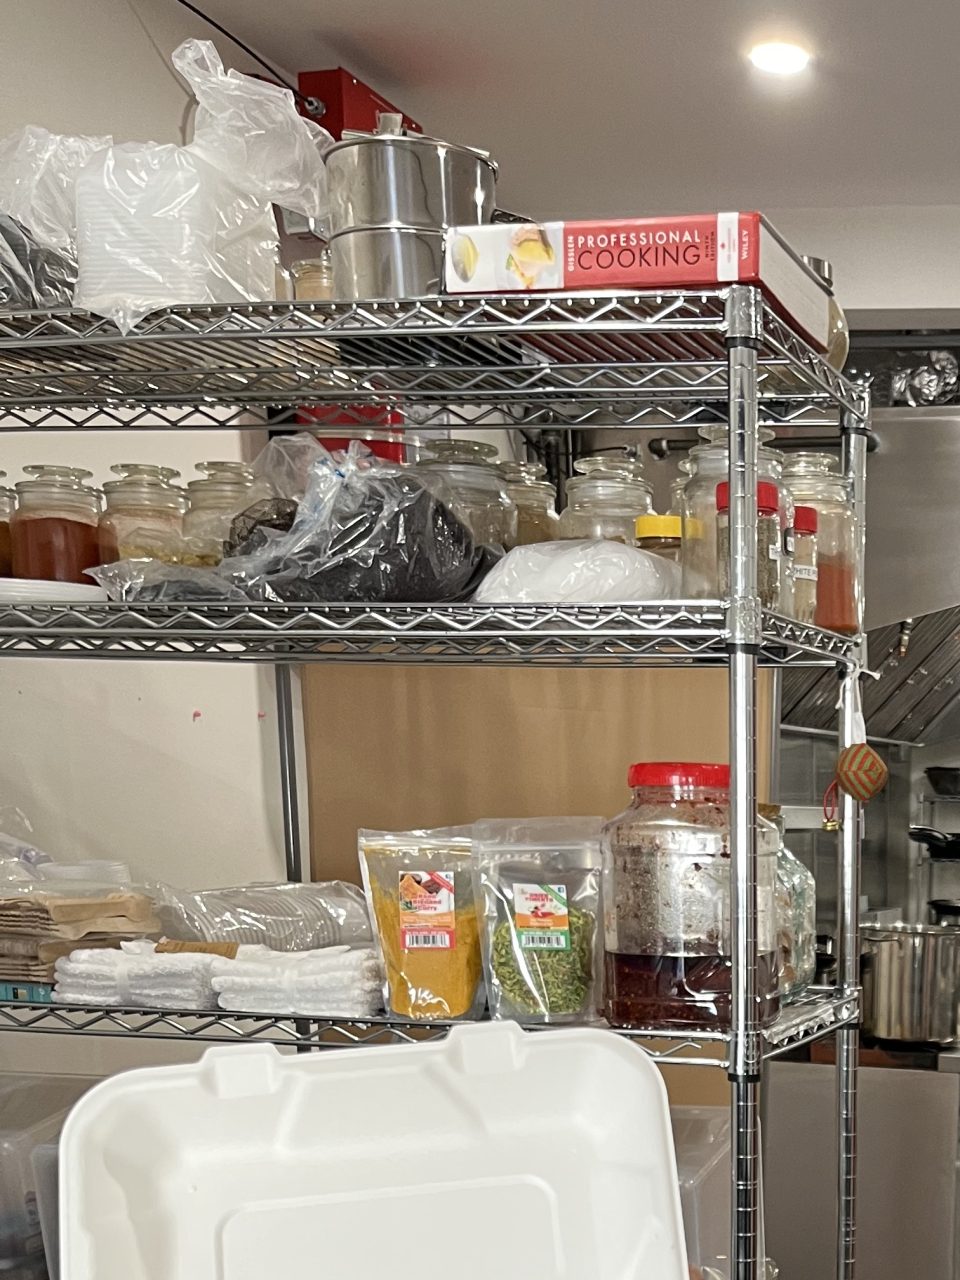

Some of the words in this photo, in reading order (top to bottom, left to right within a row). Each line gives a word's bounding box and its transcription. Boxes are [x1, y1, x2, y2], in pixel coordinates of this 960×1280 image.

[577, 229, 701, 248] PROFESSIONAL
[741, 229, 749, 260] WILEY
[567, 235, 575, 272] GISSLEN
[577, 244, 701, 270] COOKING
